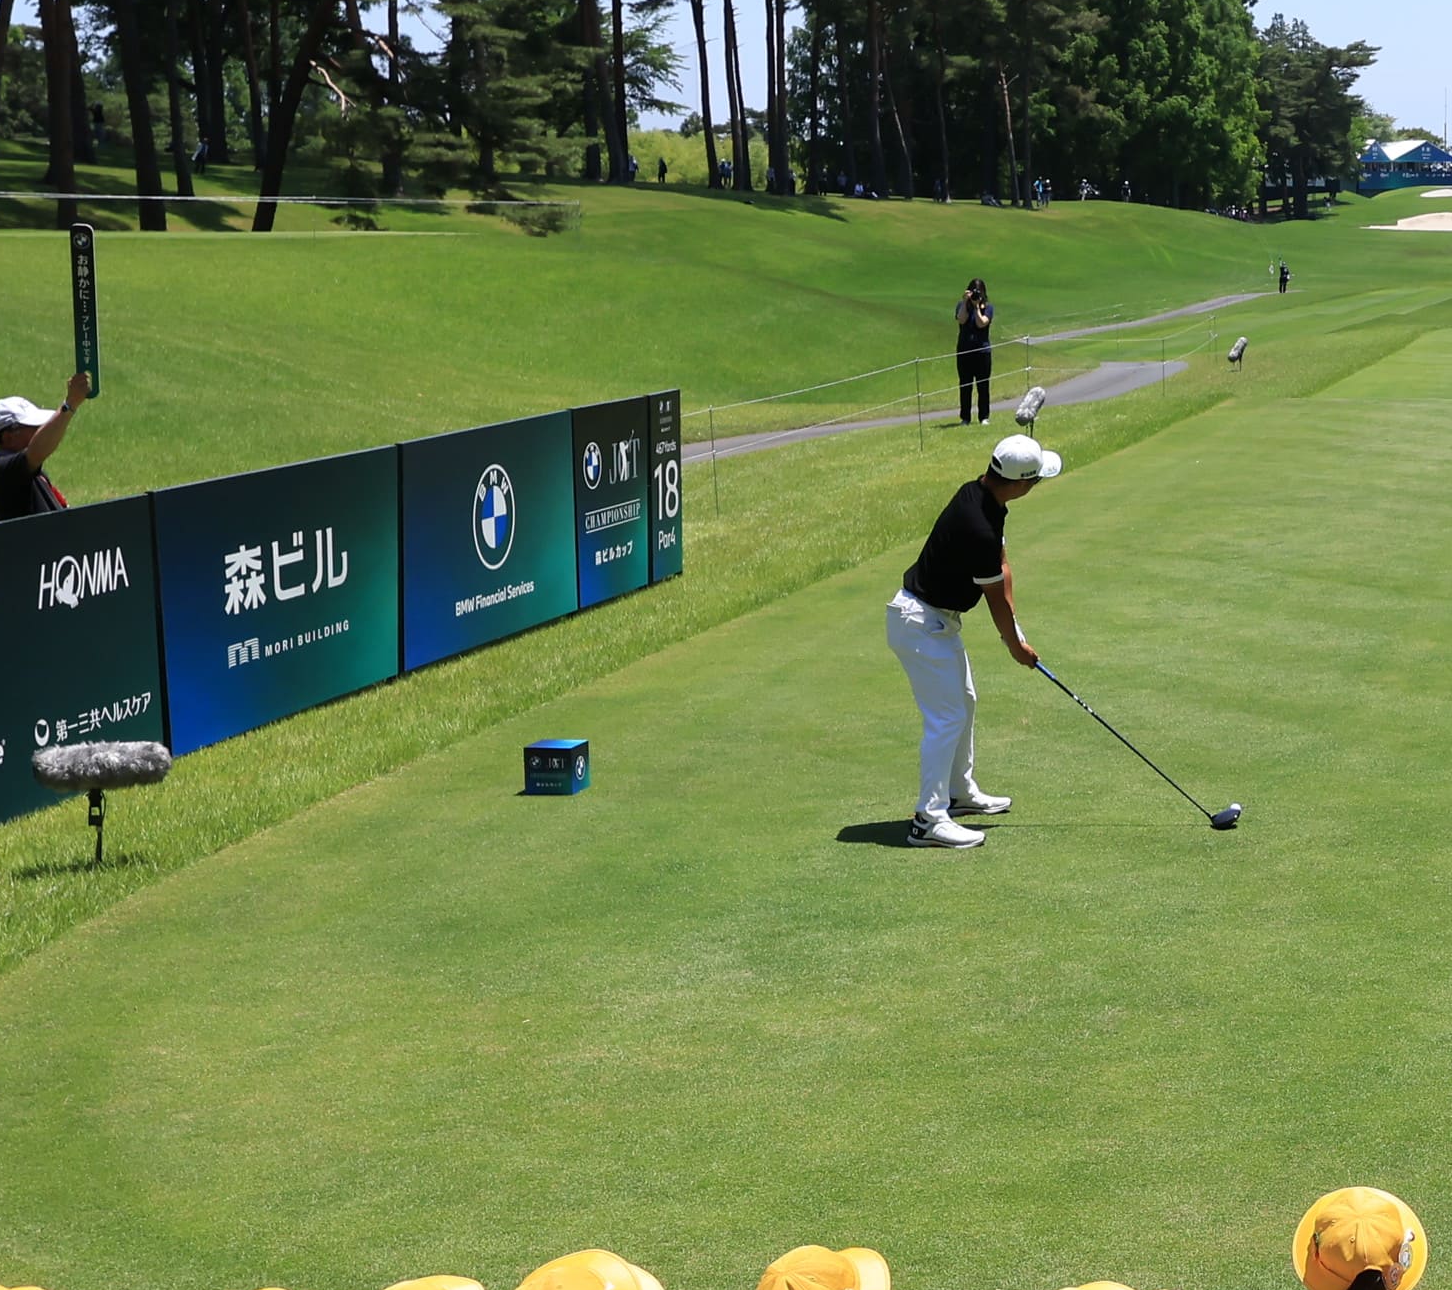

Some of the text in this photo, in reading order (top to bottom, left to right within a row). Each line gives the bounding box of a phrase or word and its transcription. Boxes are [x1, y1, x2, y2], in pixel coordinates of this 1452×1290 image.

[653, 459, 679, 521] 18
[585, 502, 641, 530] CHAMPIONSHIP
[38, 546, 129, 610] HONMA
[224, 527, 348, 616] 森ビル
[455, 580, 534, 617] BMW Financial Services
[265, 620, 349, 657] MORI BUILDING
[55, 692, 152, 742] 第一三共ヘルスケア
